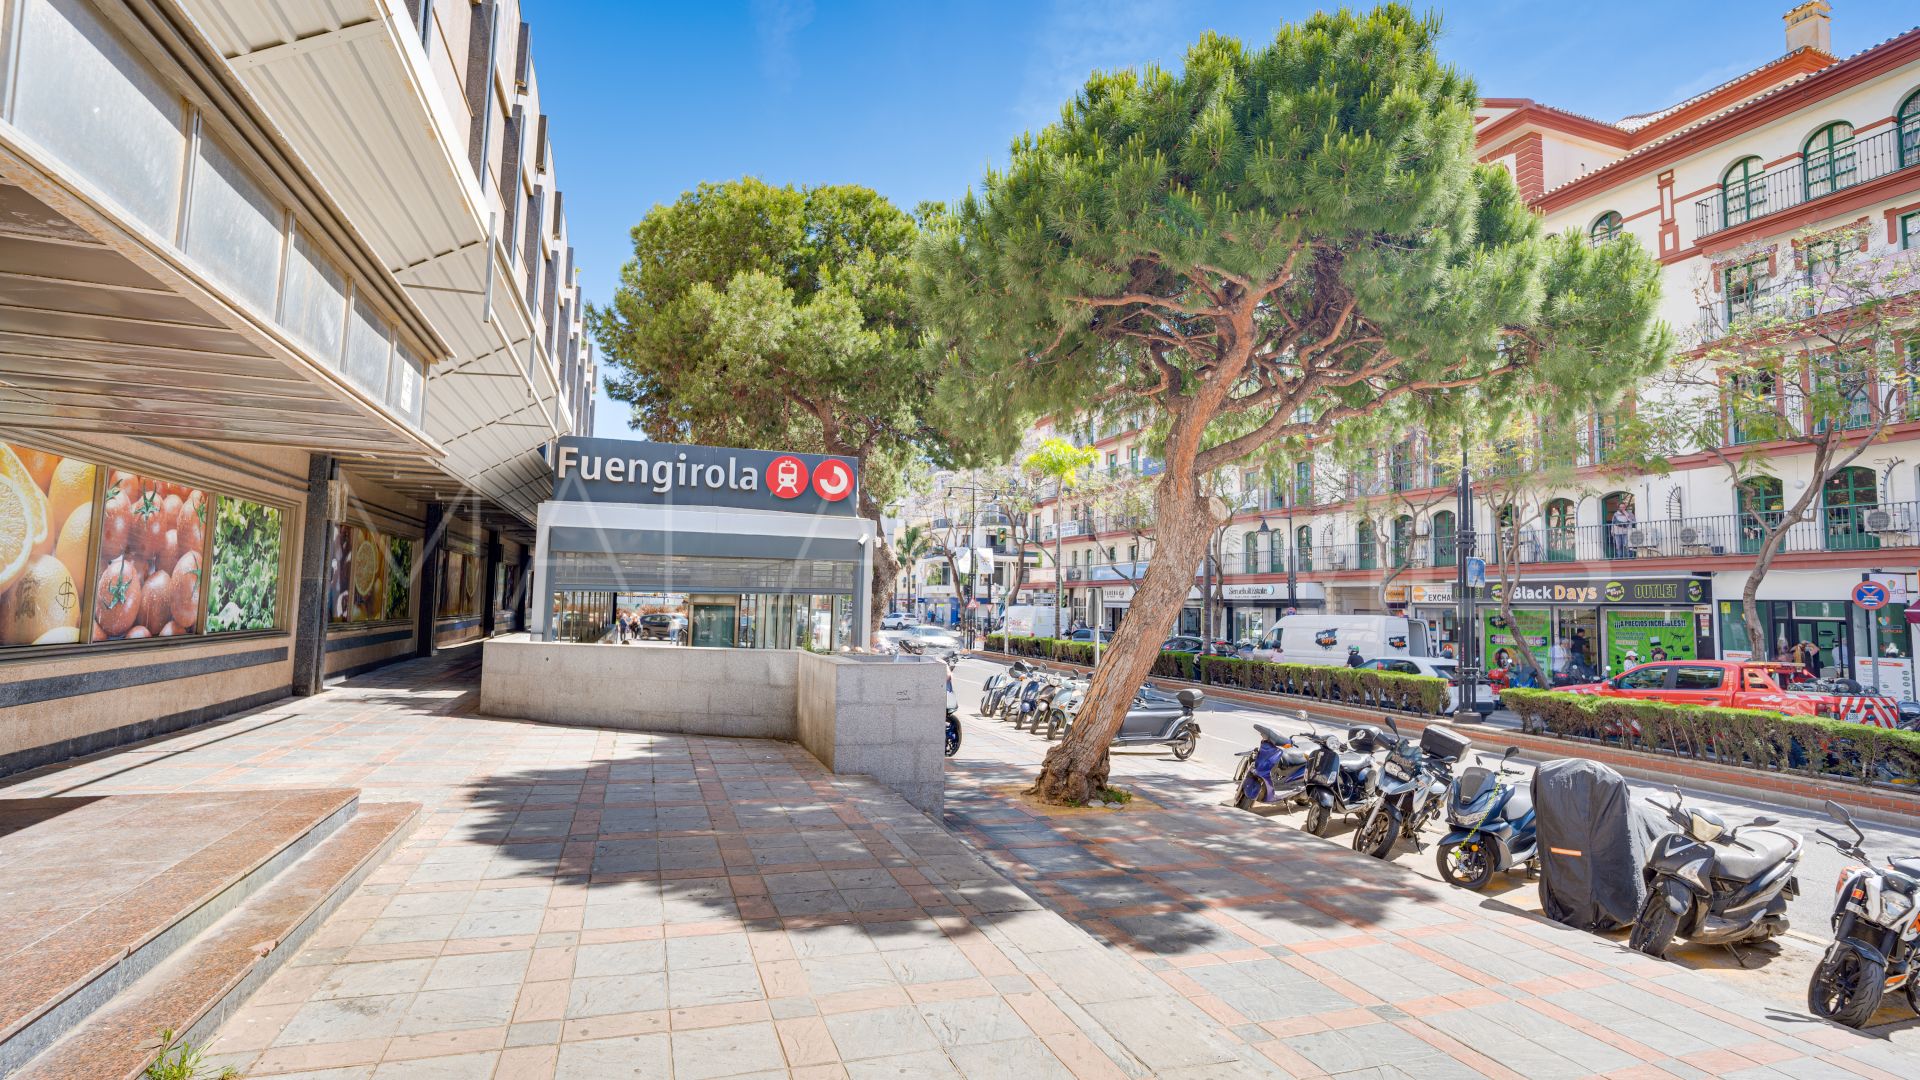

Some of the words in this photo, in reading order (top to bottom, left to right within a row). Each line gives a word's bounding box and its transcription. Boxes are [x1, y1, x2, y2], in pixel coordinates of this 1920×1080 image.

[557, 446, 758, 493] Fuengirola
[1513, 586, 1552, 600] Black
[1554, 585, 1597, 603] Days
[1634, 584, 1677, 599] OUTLET
